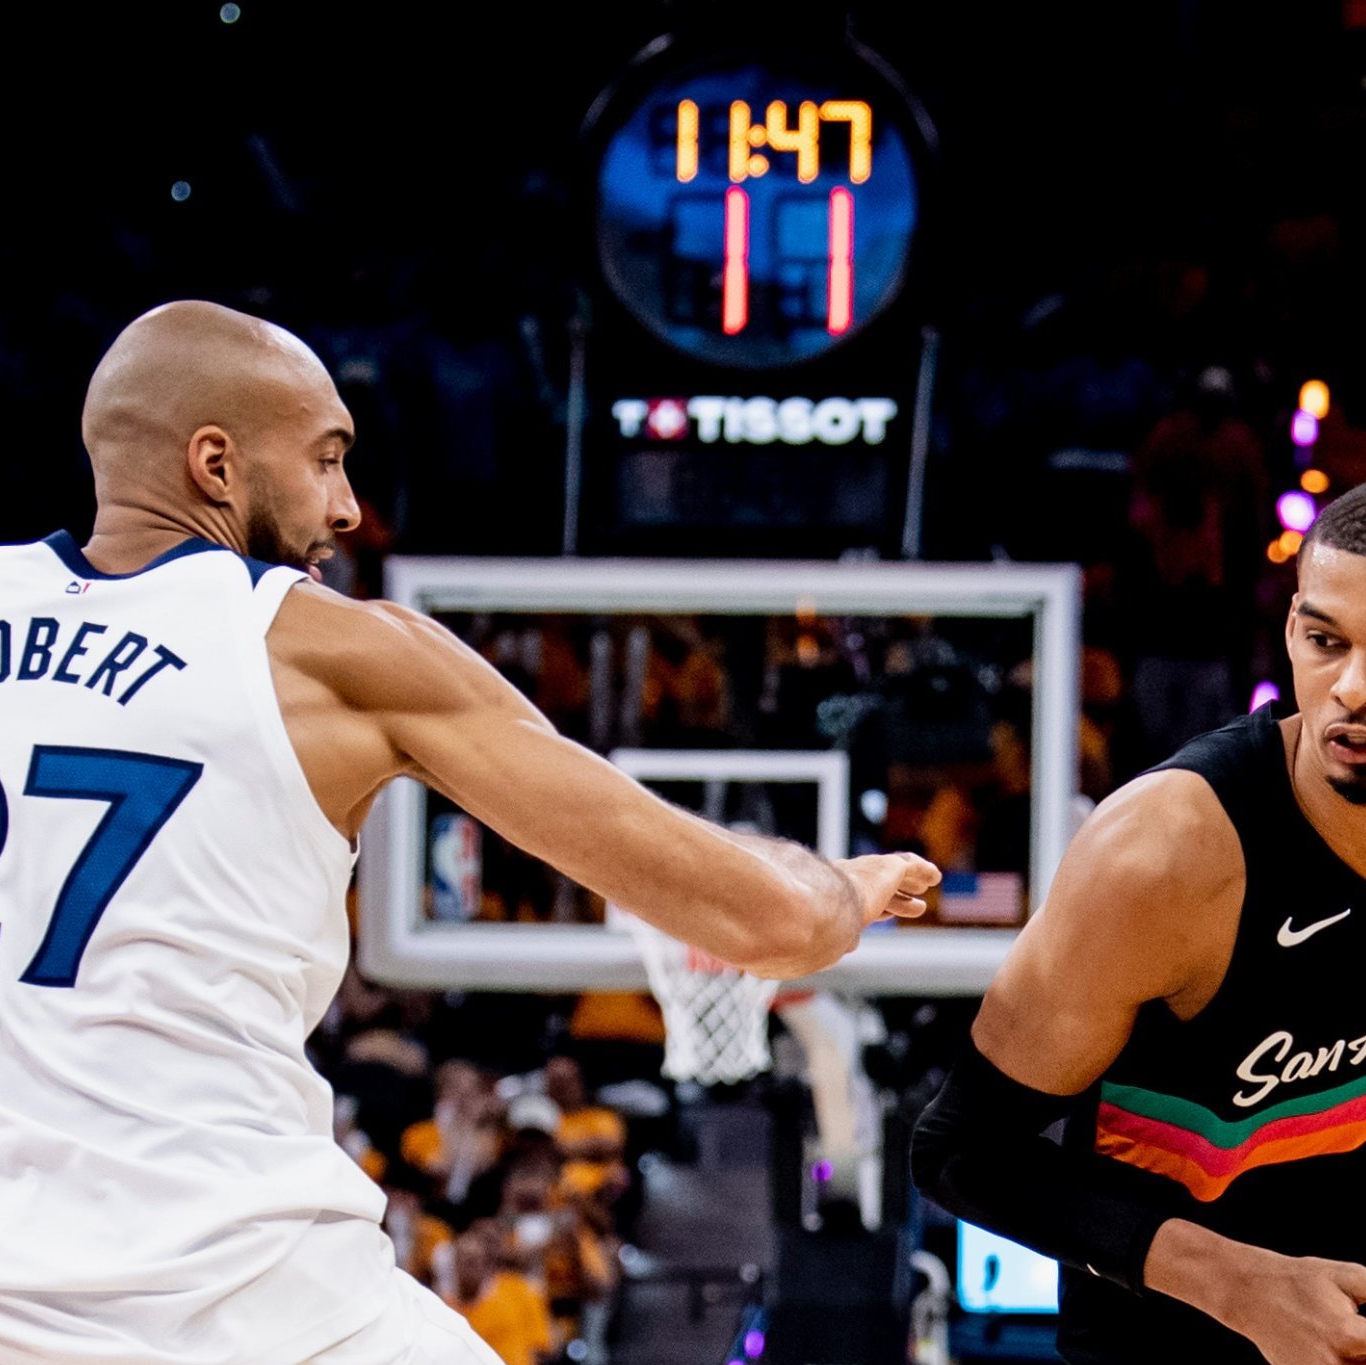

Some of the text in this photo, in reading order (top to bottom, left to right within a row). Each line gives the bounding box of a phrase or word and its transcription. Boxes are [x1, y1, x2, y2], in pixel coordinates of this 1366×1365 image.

[676, 99, 873, 184] 11:47
[687, 396, 898, 445] TISSOT
[1233, 1030, 1346, 1107] San
